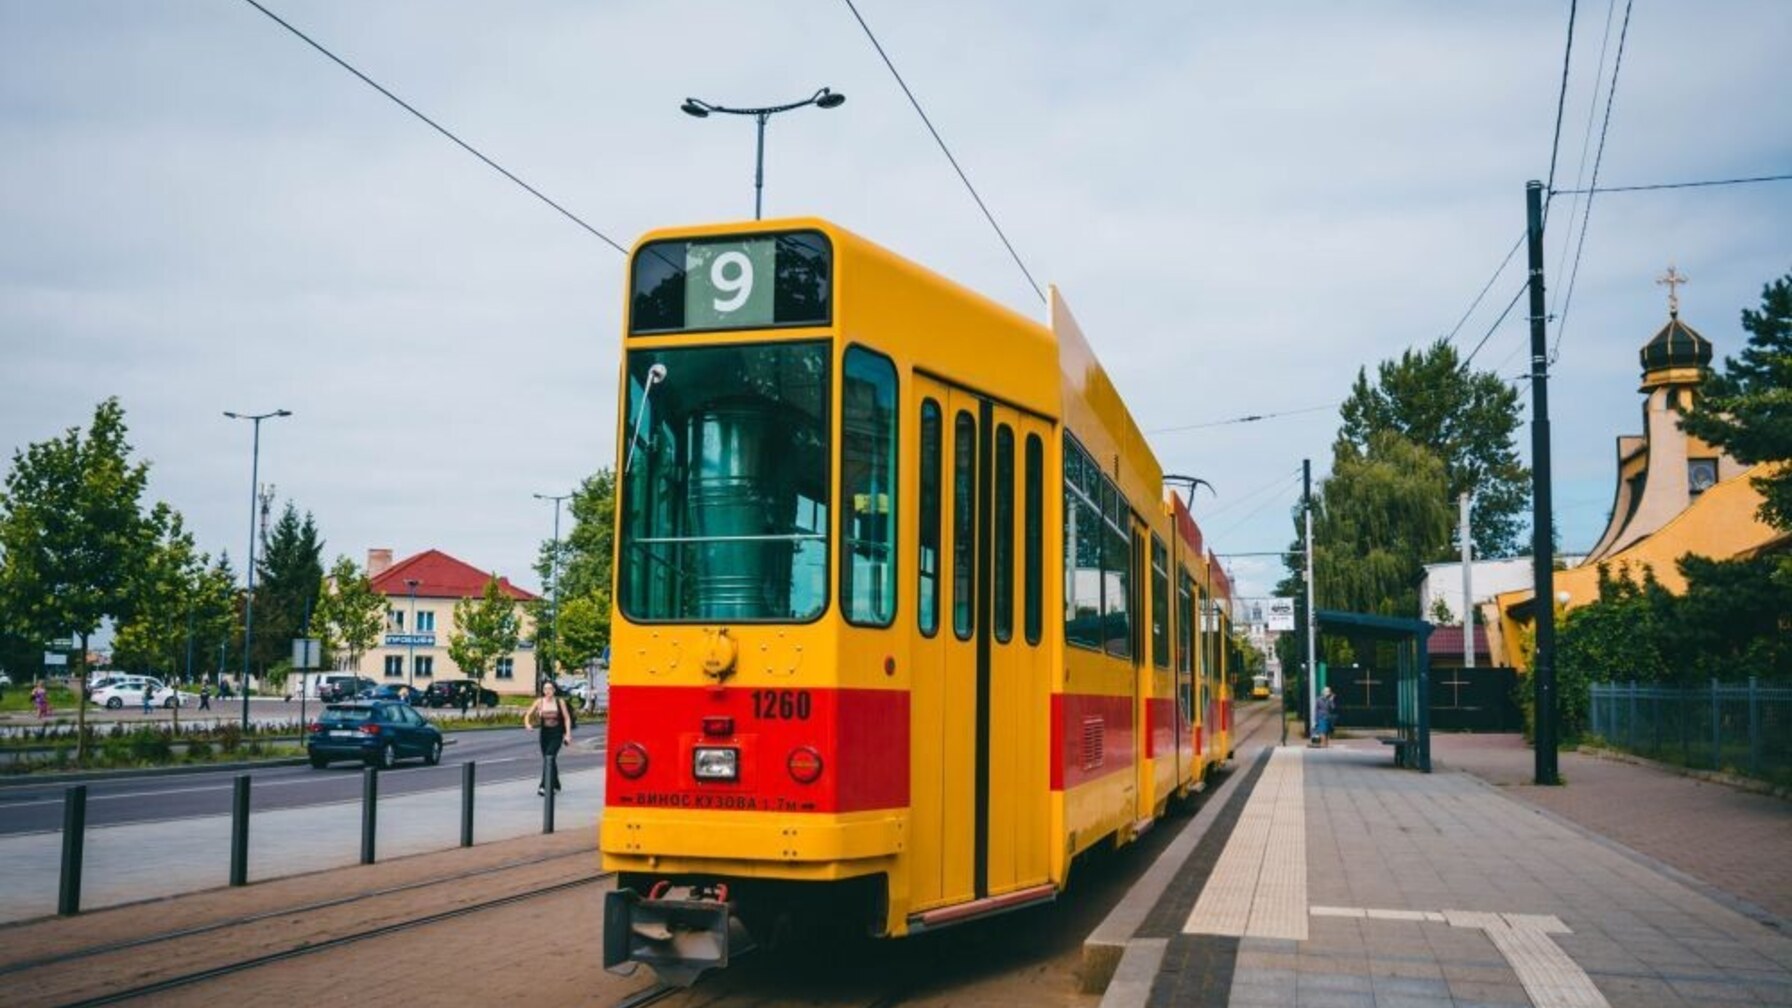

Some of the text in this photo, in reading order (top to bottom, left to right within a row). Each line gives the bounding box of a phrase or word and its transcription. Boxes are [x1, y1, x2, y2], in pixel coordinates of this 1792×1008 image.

[711, 251, 754, 312] 9
[752, 689, 811, 720] 1260
[636, 793, 690, 806] ВИНОС
[696, 795, 756, 809] КУЗОВА
